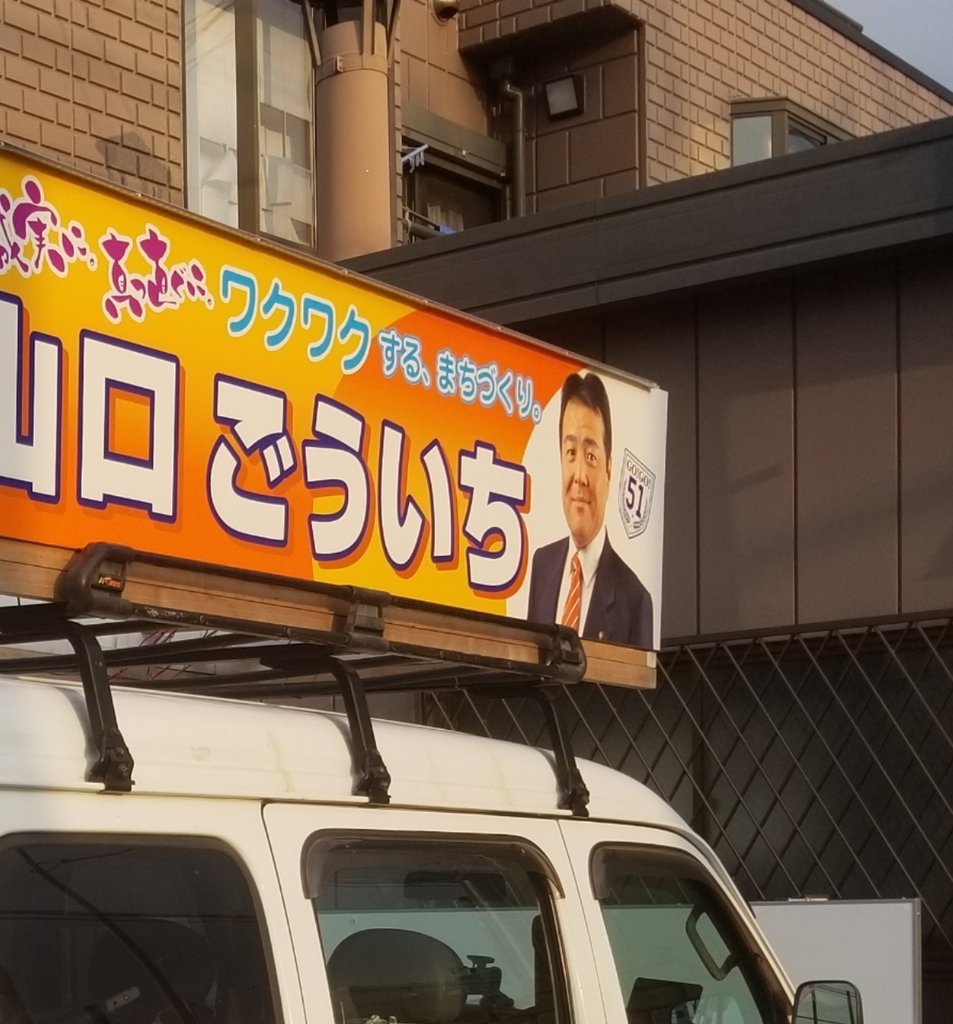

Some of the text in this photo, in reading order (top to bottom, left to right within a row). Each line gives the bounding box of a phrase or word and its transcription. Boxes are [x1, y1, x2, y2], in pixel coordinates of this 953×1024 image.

[206, 373, 532, 592] ごういち
[625, 474, 645, 519] 51
